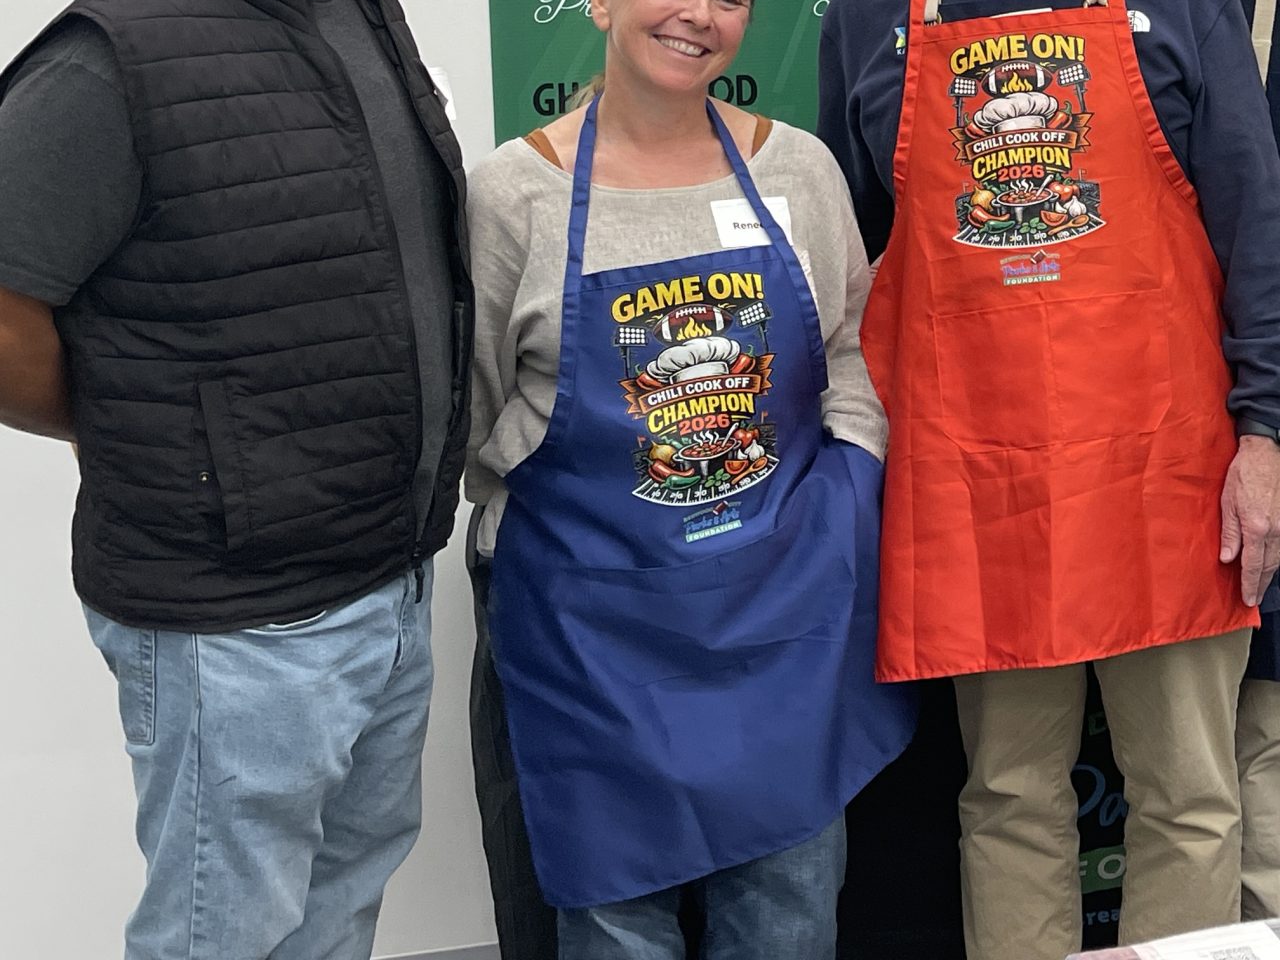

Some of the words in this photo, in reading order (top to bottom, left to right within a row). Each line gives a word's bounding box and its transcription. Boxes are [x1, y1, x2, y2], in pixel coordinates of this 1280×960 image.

[950, 34, 1028, 75] GAME
[1031, 33, 1085, 62] ON!
[973, 137, 1004, 153] CHILI
[1006, 132, 1039, 144] COOK
[1041, 131, 1066, 143] OFF
[972, 147, 1071, 180] CHAMPION
[997, 165, 1045, 182] 2026
[733, 222, 762, 230] Rene
[1006, 275, 1058, 285] FOUNDATION
[611, 275, 704, 323] GAME
[707, 272, 765, 300] ON!
[647, 386, 683, 407] CHILI
[685, 379, 722, 395] COOK
[725, 377, 750, 389] OFF
[647, 393, 755, 434] CHAMPION
[678, 414, 731, 436] 2026
